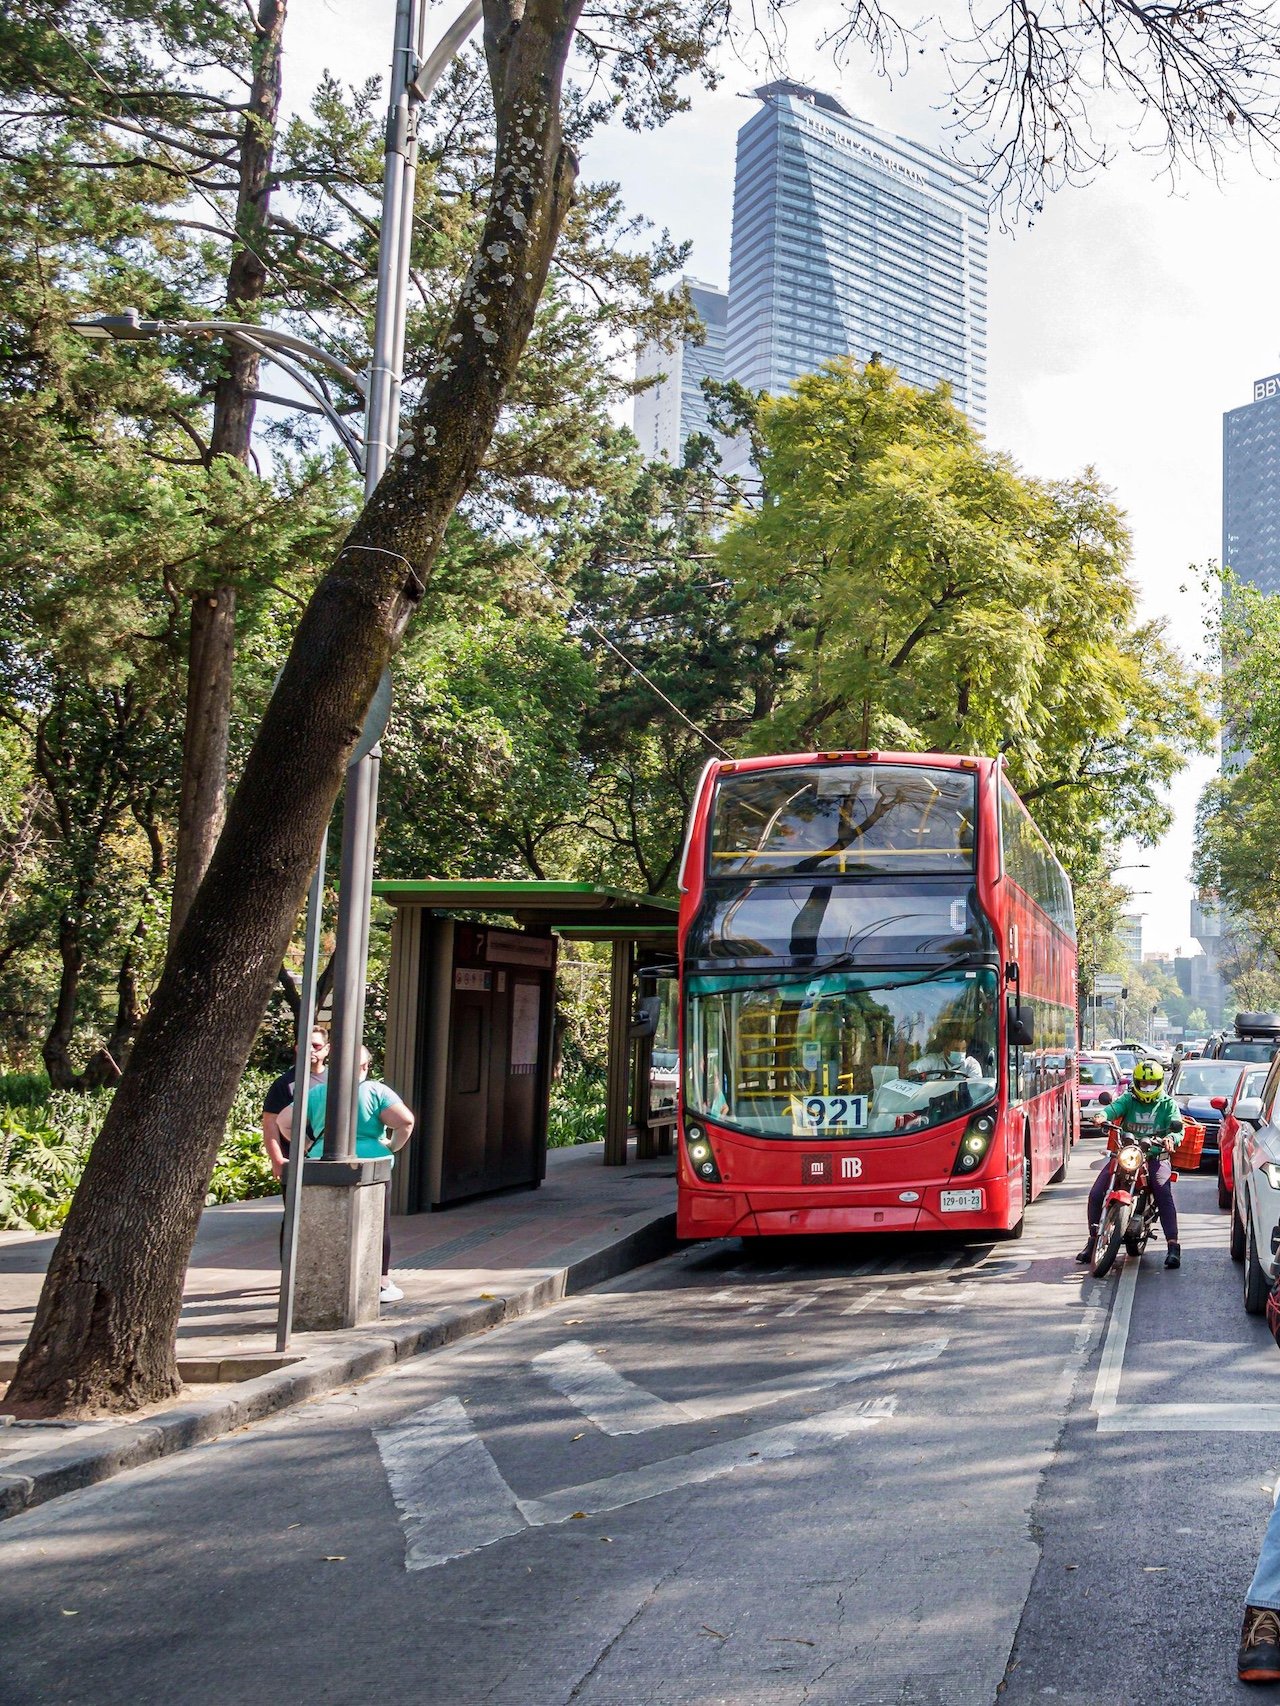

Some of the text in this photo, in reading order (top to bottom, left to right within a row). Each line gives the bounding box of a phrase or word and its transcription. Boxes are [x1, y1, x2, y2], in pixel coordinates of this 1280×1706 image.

[804, 116, 831, 135] THE
[807, 1098, 862, 1126] 921
[841, 1157, 863, 1178] MB
[943, 1196, 980, 1206] 129-01-23
